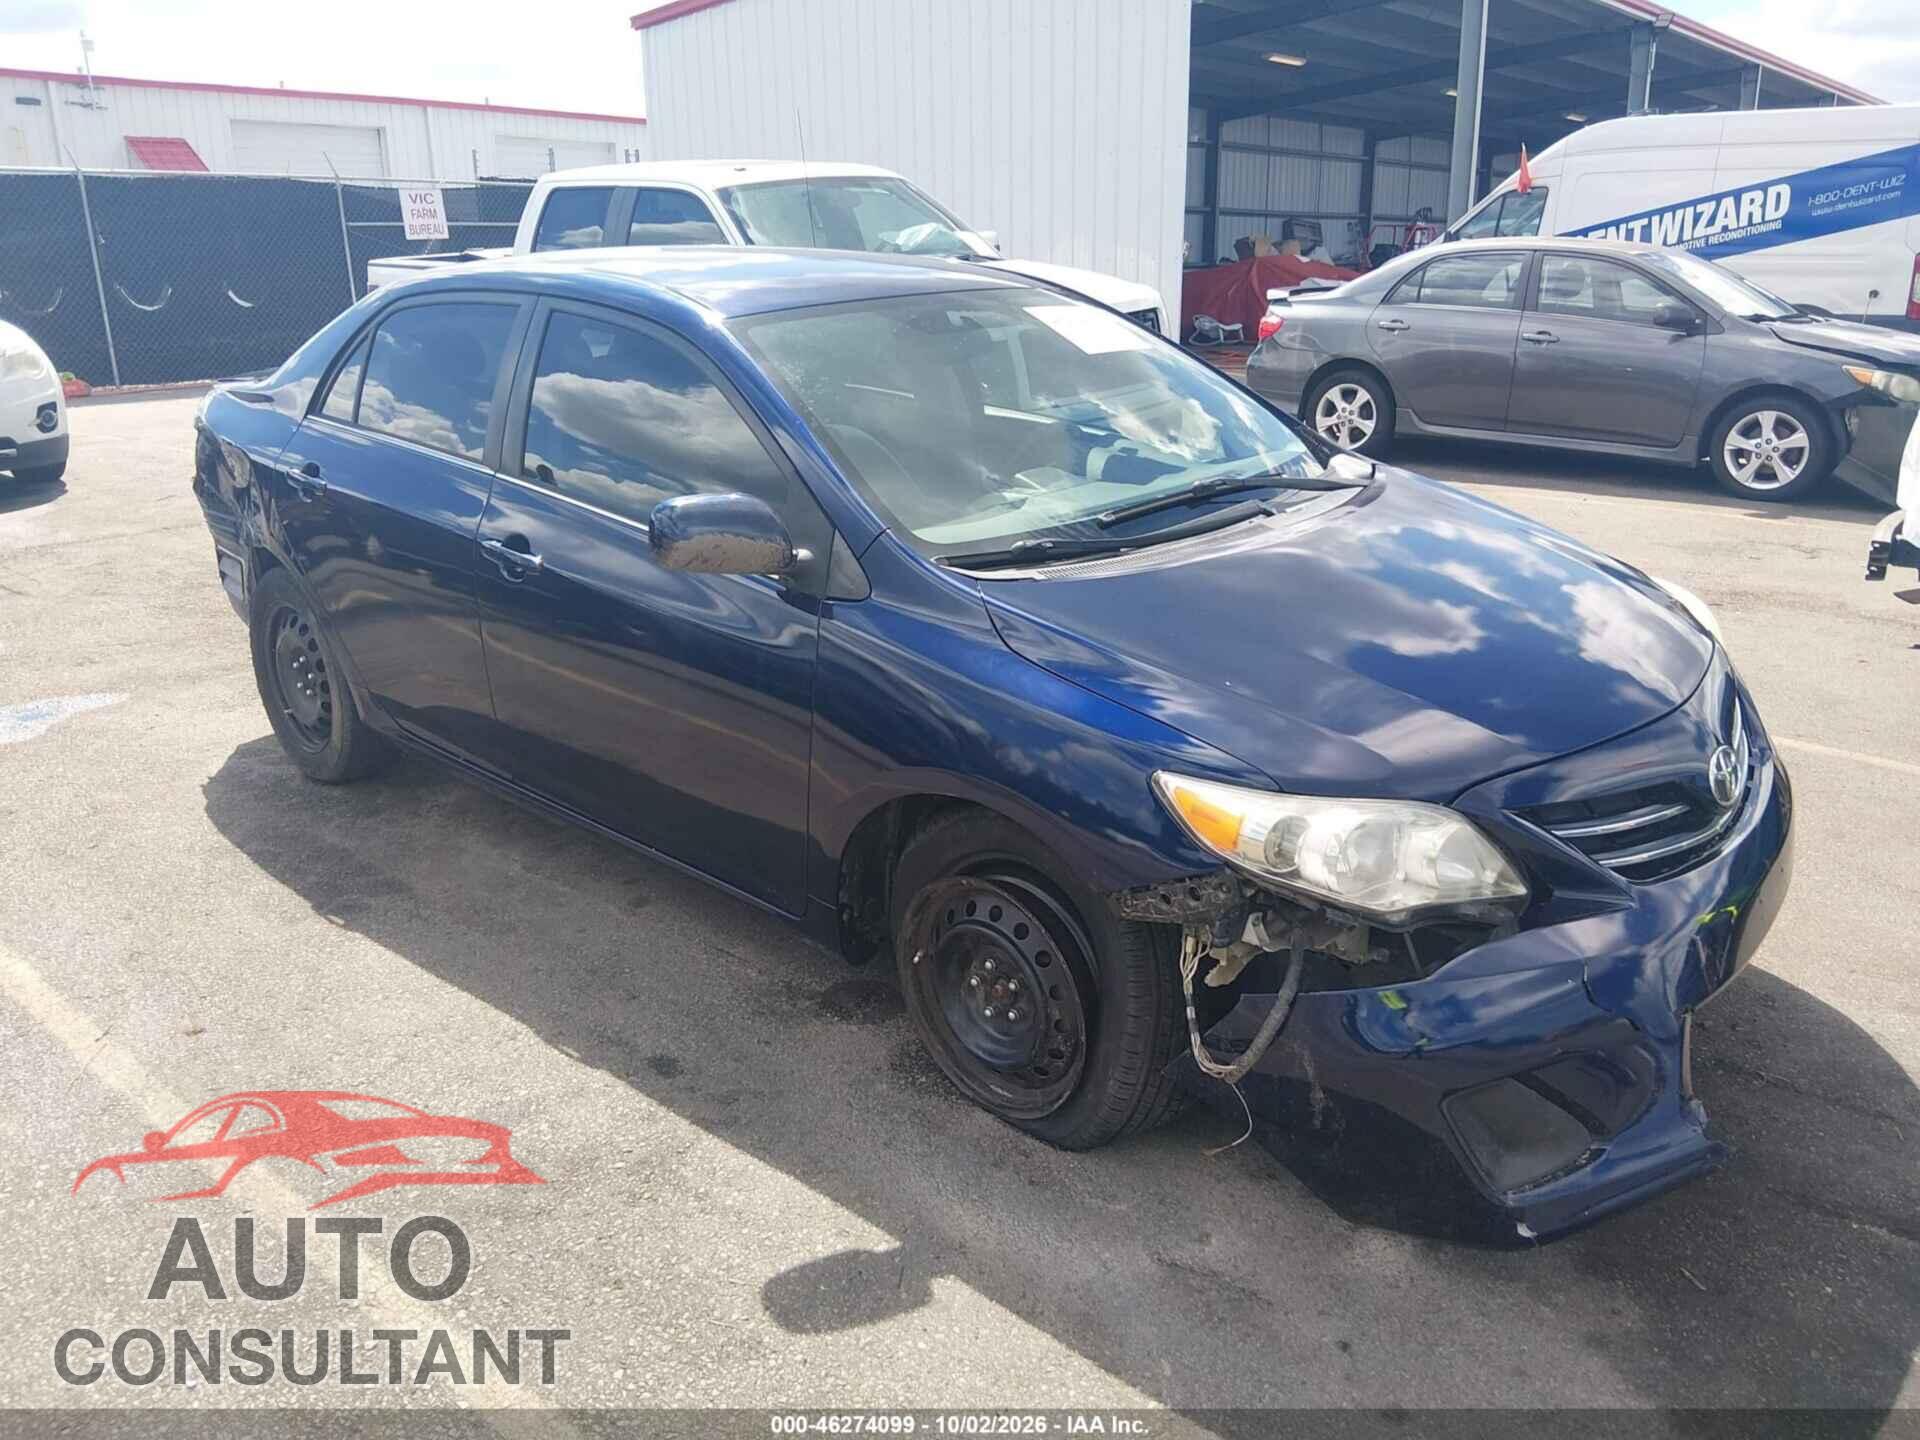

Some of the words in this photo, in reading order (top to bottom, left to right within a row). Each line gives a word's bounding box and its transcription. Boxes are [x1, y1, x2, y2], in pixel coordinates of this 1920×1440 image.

[408, 193, 435, 205] VIC
[410, 208, 438, 220] FARM
[1651, 184, 1791, 249] WIZARD
[409, 223, 445, 235] BUREAU
[1708, 220, 1782, 246] RECONDITIONING
